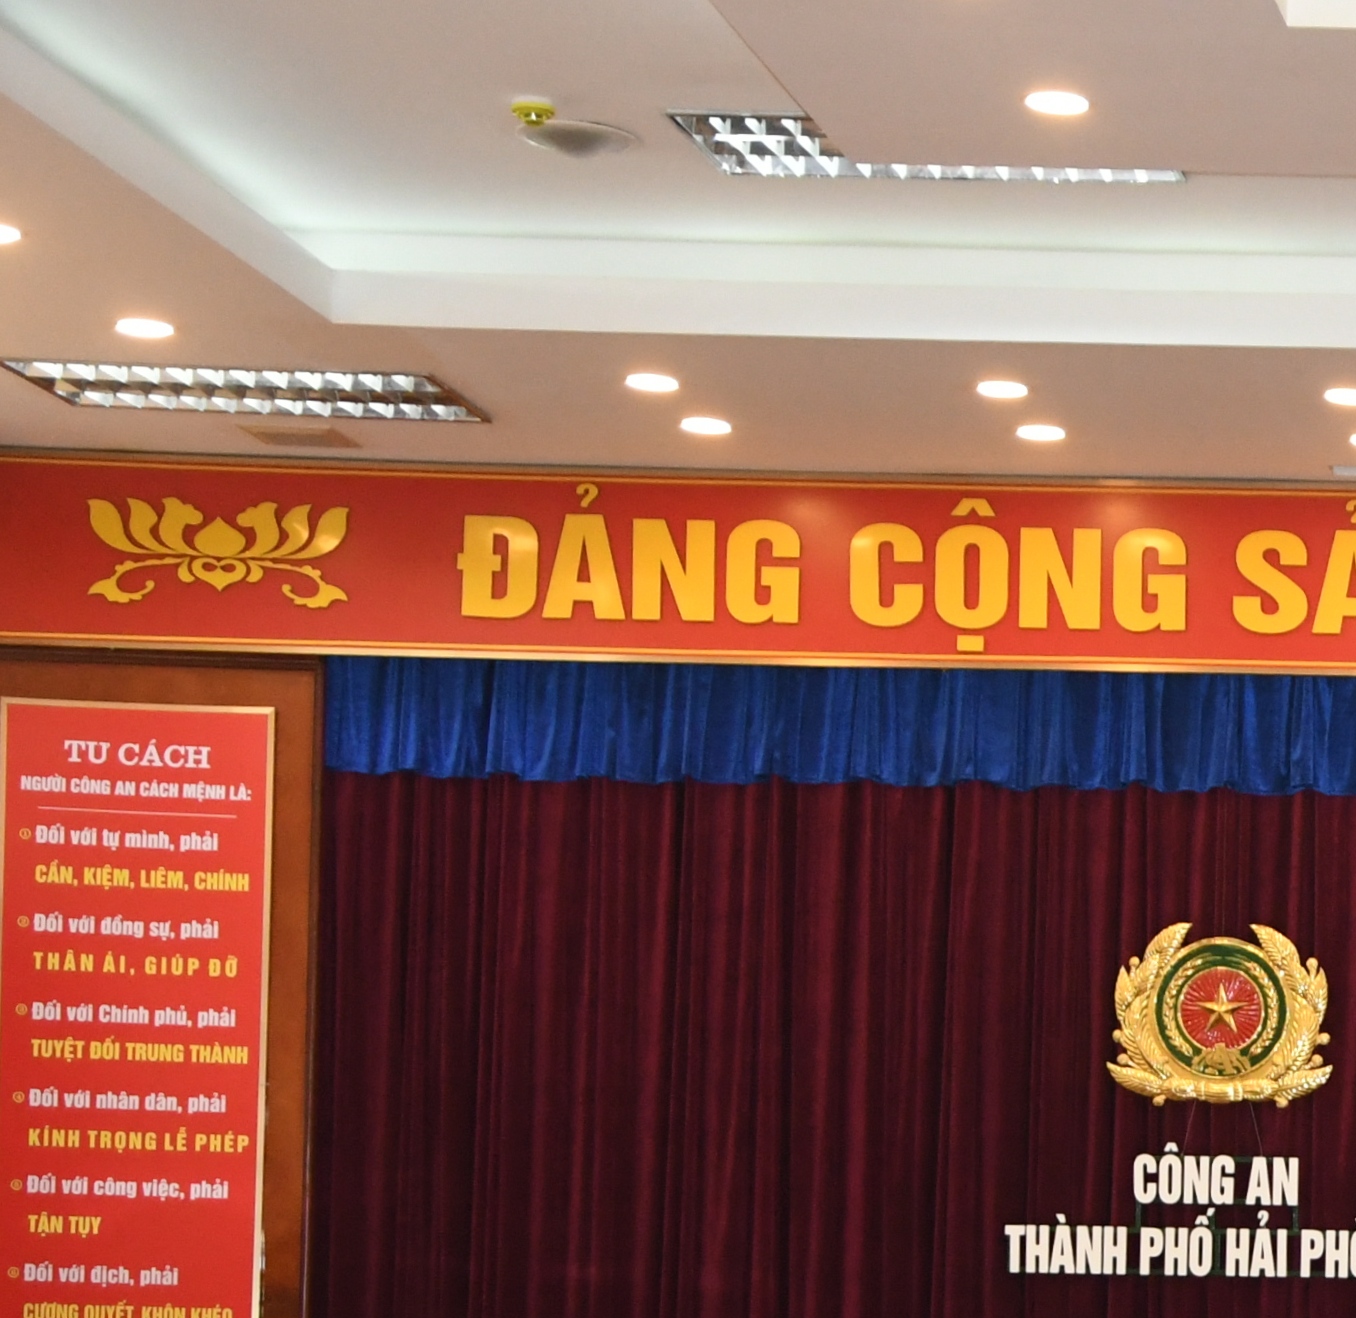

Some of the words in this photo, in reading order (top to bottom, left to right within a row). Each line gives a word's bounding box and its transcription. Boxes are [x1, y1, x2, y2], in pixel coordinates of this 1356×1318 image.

[457, 485, 800, 627] ĐẢNG
[849, 496, 1187, 652] CỘNG
[119, 740, 210, 767] CÁCH
[22, 775, 65, 791] NGƯỜI
[72, 777, 110, 793] CÔNG
[116, 782, 134, 795] AN
[141, 781, 178, 796] CÁCH
[184, 783, 225, 800] MỆNH
[231, 784, 250, 799] LÀ:
[37, 825, 63, 843] Đối
[72, 829, 95, 844] với
[103, 830, 119, 849] tự
[126, 832, 173, 850] mình,
[181, 832, 217, 851] phải
[36, 861, 77, 885] CẦN,
[85, 865, 133, 888] KIỆM,
[141, 868, 187, 890] LIÊM,
[196, 870, 248, 890] CHÍNH
[32, 1038, 84, 1060] TUYỆT
[91, 1037, 119, 1059] ĐỐI
[127, 1044, 183, 1061] TRUNG
[191, 1044, 247, 1063] THÀNH
[1135, 1143, 1234, 1203] CÔNG
[1247, 1158, 1297, 1205] AN
[29, 1213, 62, 1235] TẬN
[70, 1217, 100, 1237] TỤY
[1006, 1215, 1126, 1274] THÀNH
[1141, 1209, 1214, 1275] PHỐ
[1227, 1211, 1286, 1276] HẢI
